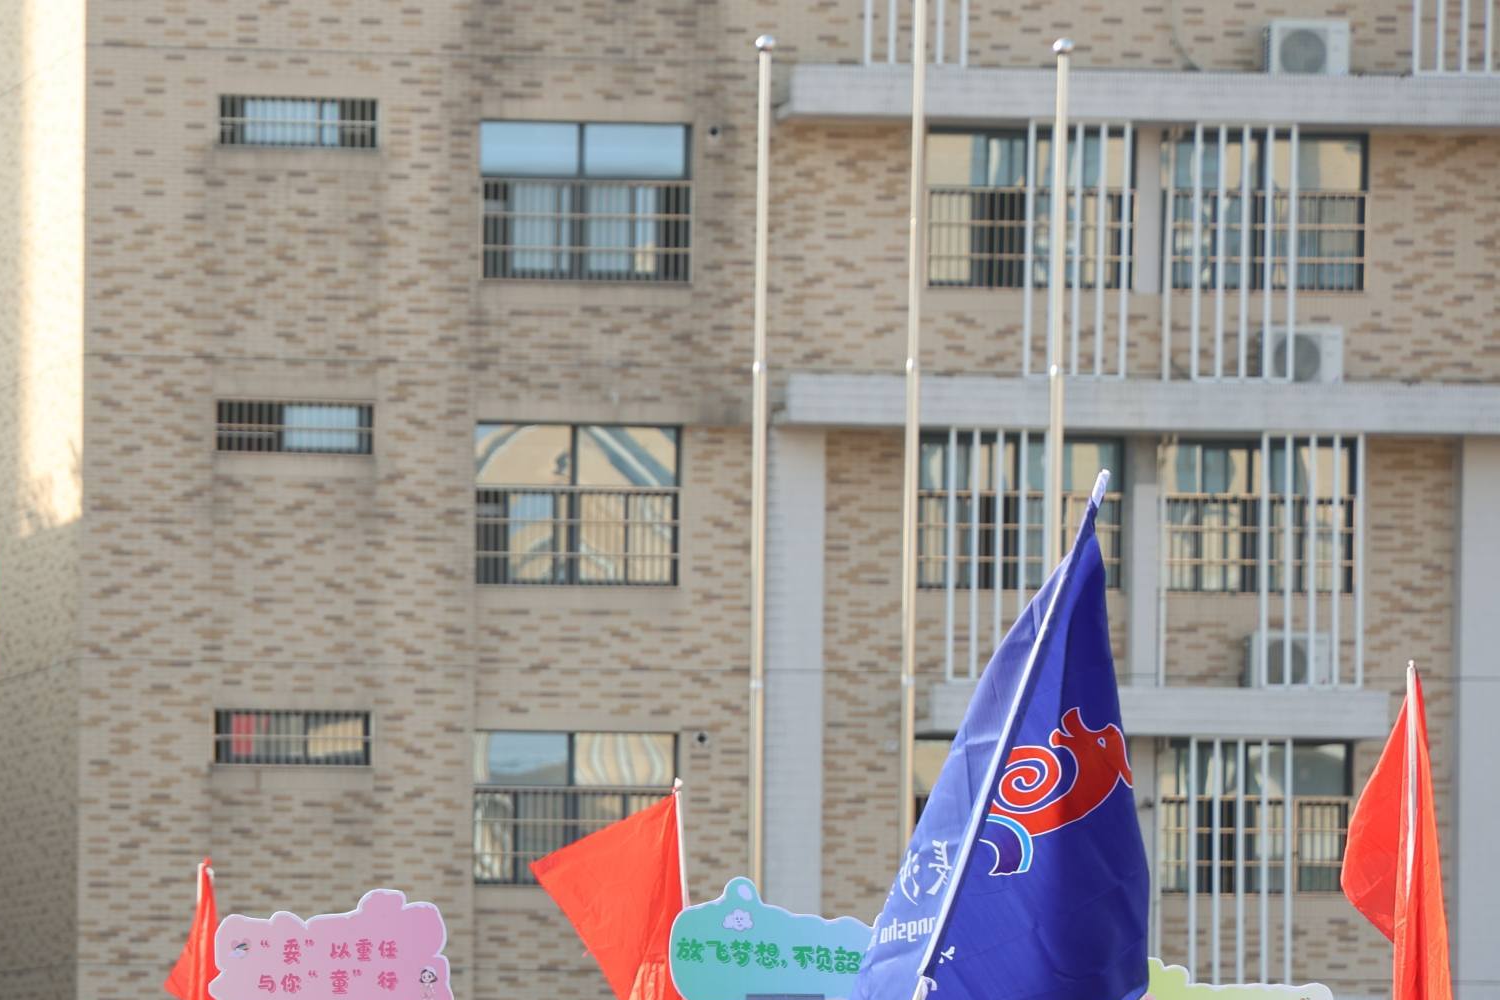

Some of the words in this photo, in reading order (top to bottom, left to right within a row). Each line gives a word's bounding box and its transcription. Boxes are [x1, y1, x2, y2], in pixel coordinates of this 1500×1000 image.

[676, 937, 867, 974] 放飞梦想，不负韶
